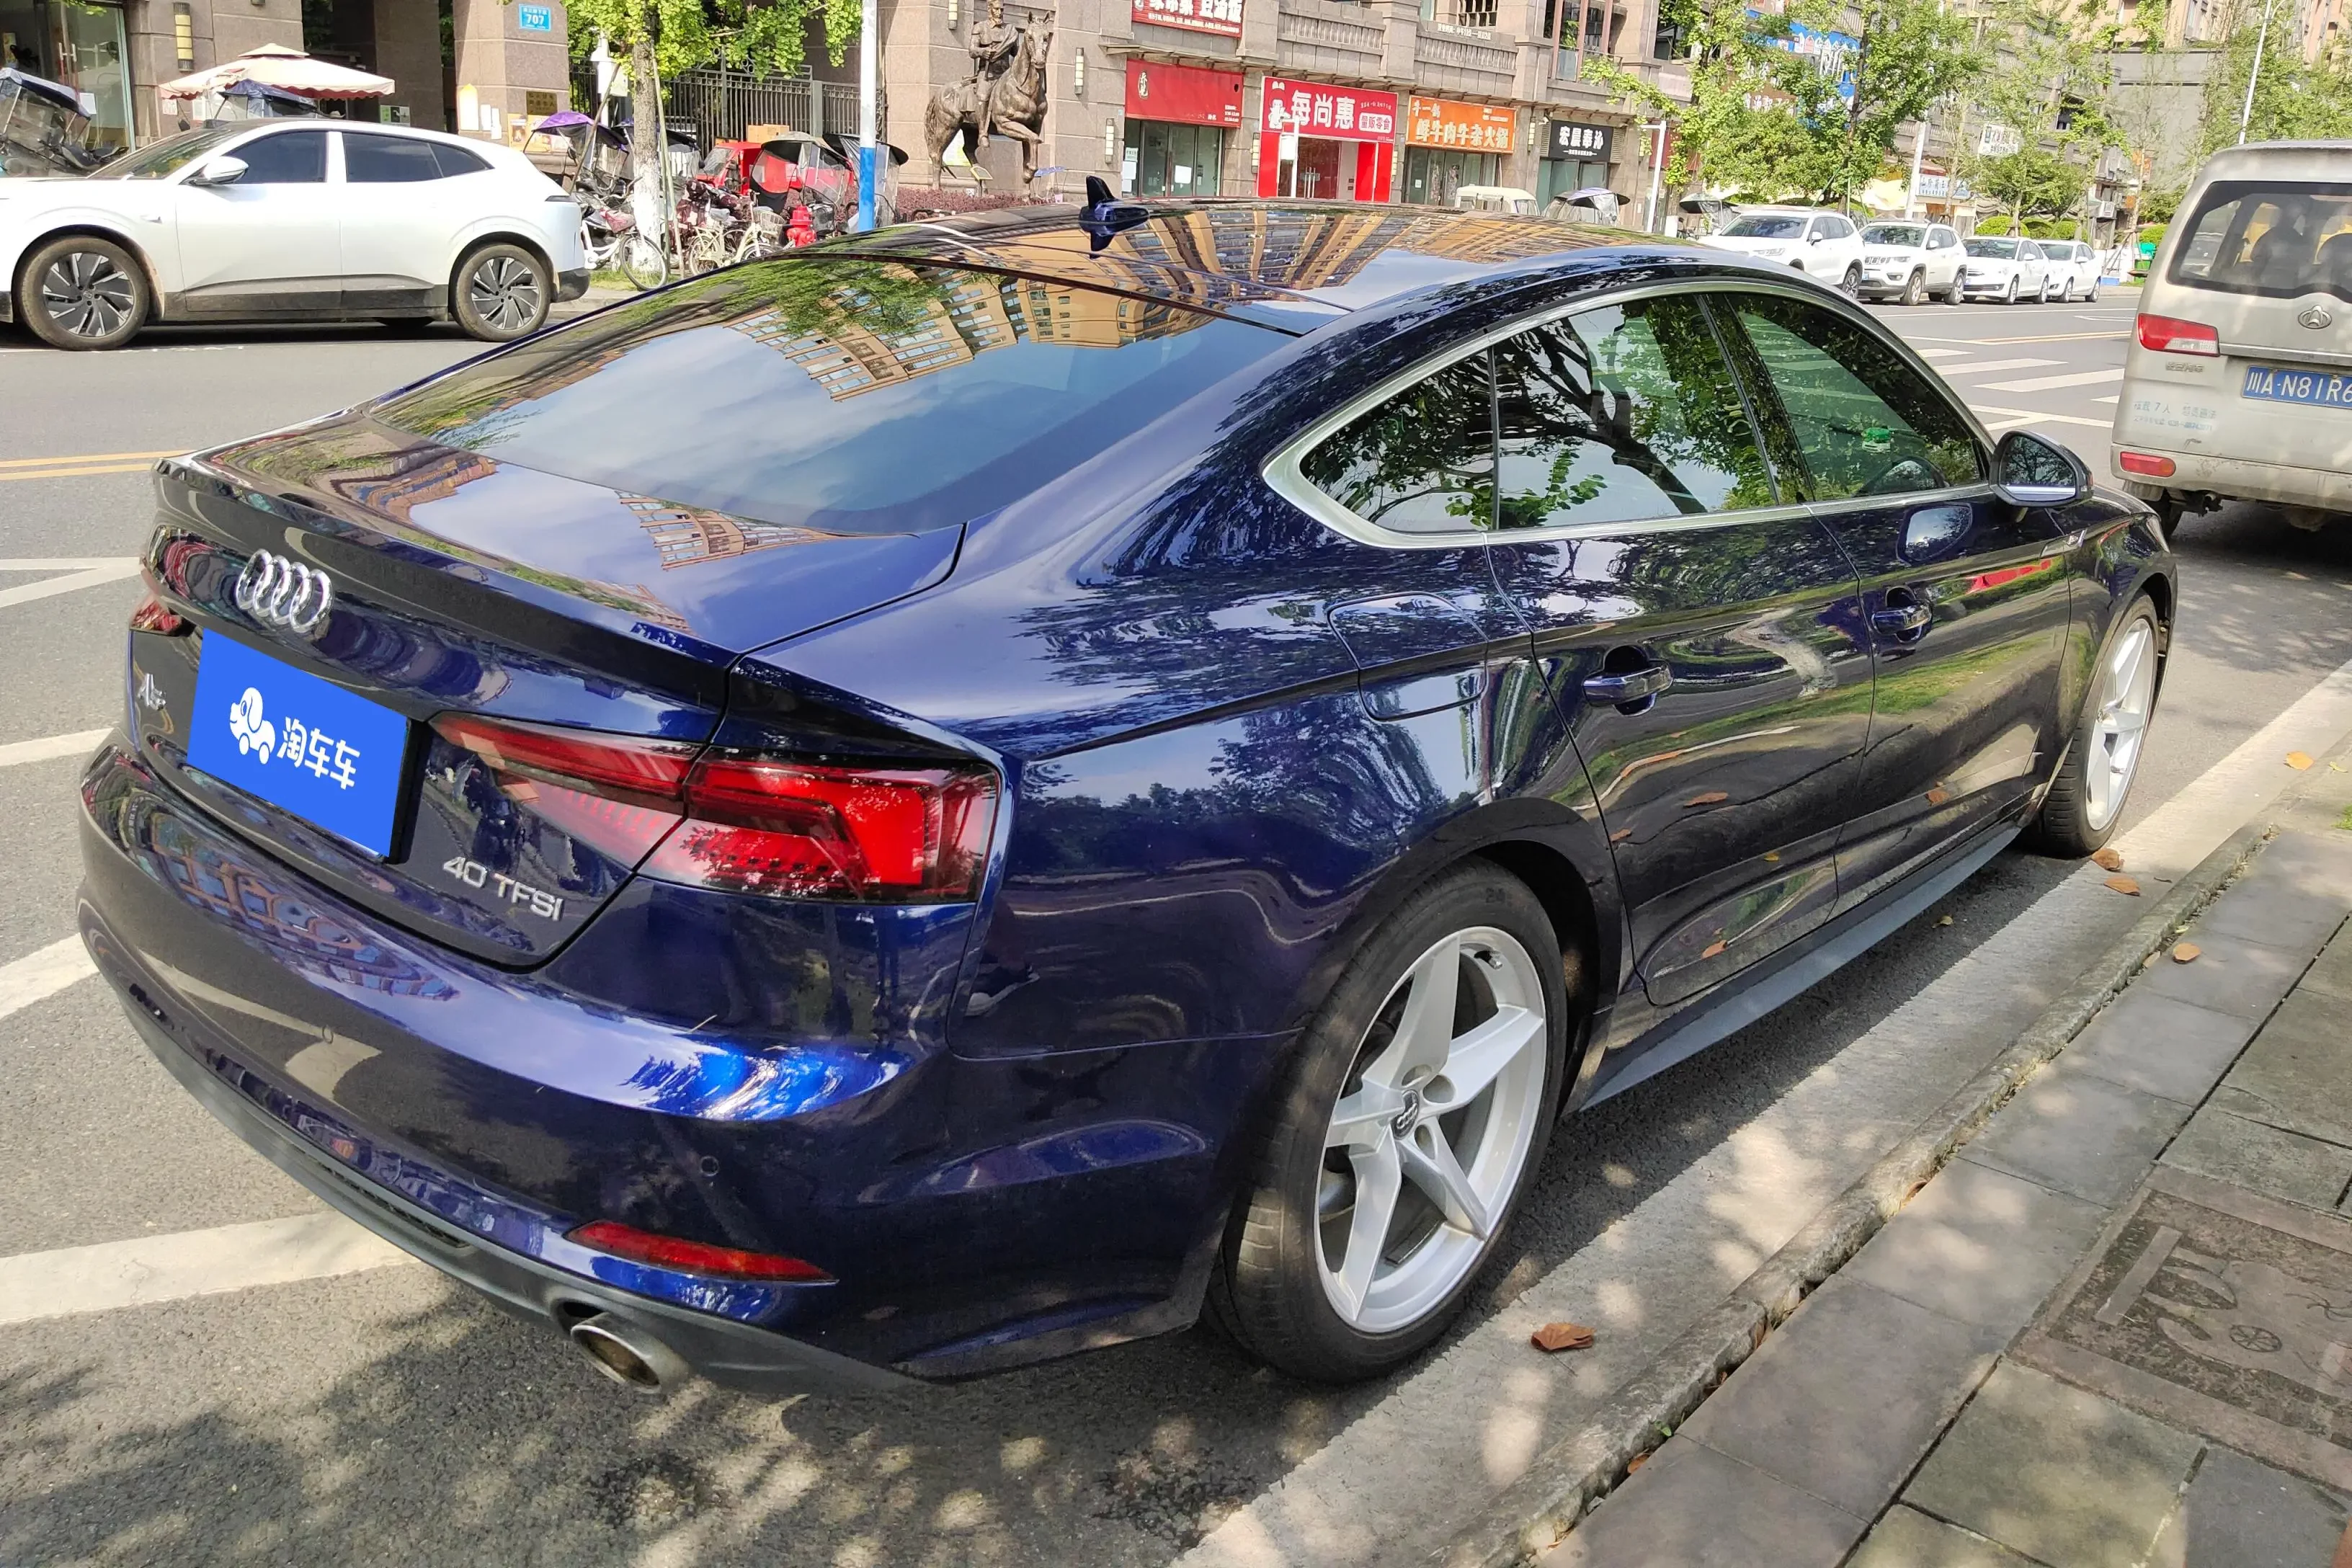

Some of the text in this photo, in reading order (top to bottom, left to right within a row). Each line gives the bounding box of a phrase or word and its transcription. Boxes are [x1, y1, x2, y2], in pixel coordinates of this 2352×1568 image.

[526, 14, 545, 25] 707
[1291, 90, 1355, 129] 每尚惠
[1361, 115, 1392, 131] 量贩零食
[1415, 118, 1510, 149] 鲜牛肉牛杂火锅
[443, 856, 564, 922] 40 TFSI
